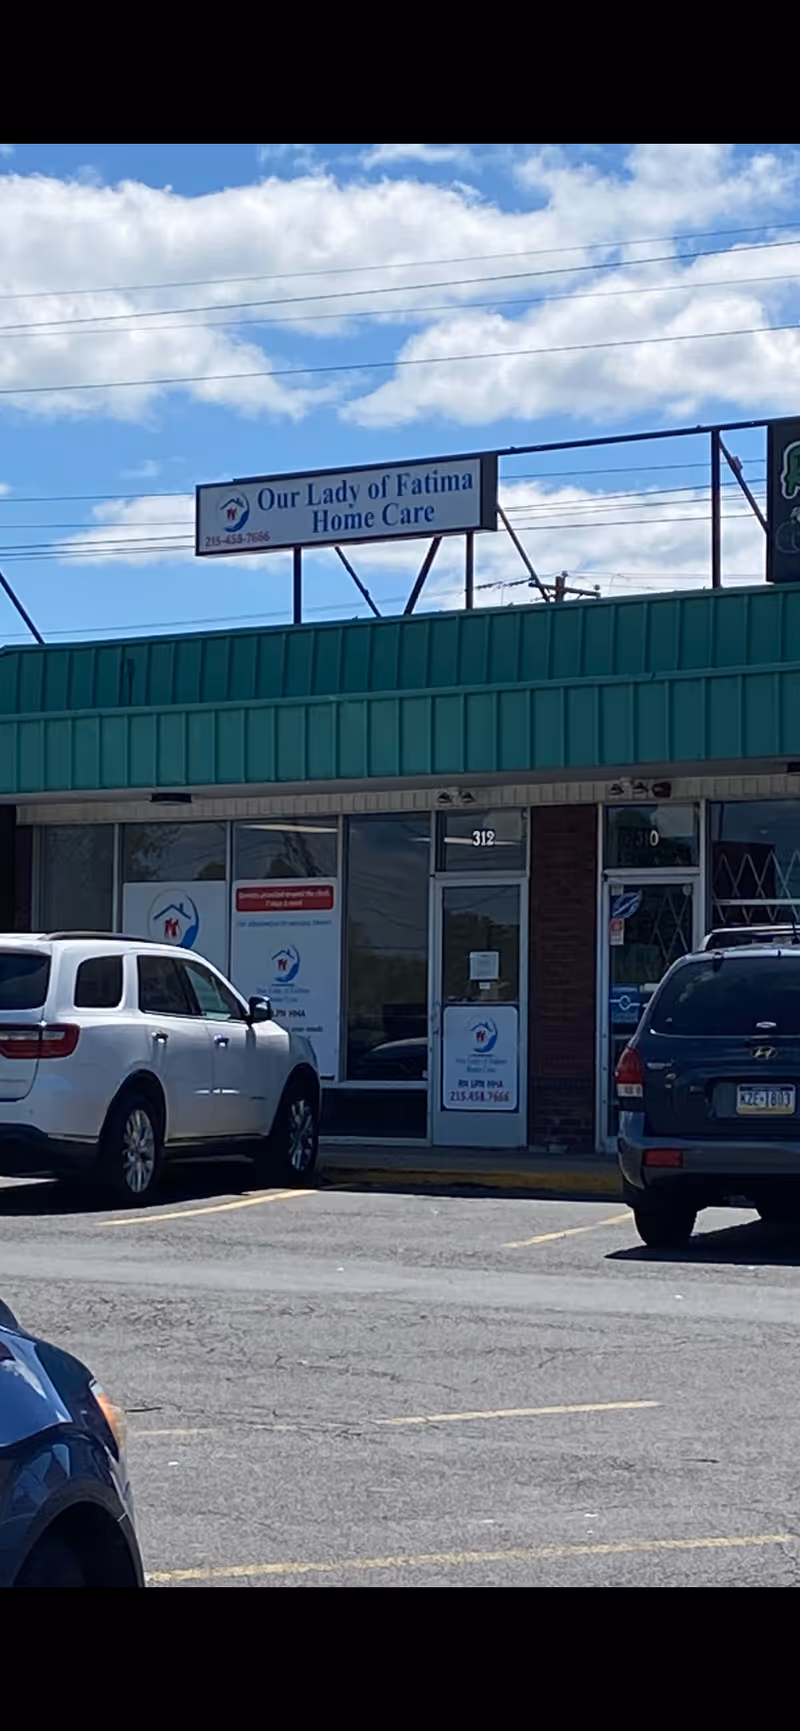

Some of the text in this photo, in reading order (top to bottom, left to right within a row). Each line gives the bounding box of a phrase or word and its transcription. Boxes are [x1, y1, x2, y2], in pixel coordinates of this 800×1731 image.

[257, 469, 474, 511] Our Lady of Fatima
[312, 502, 436, 534] Home Care
[472, 830, 495, 846] 312
